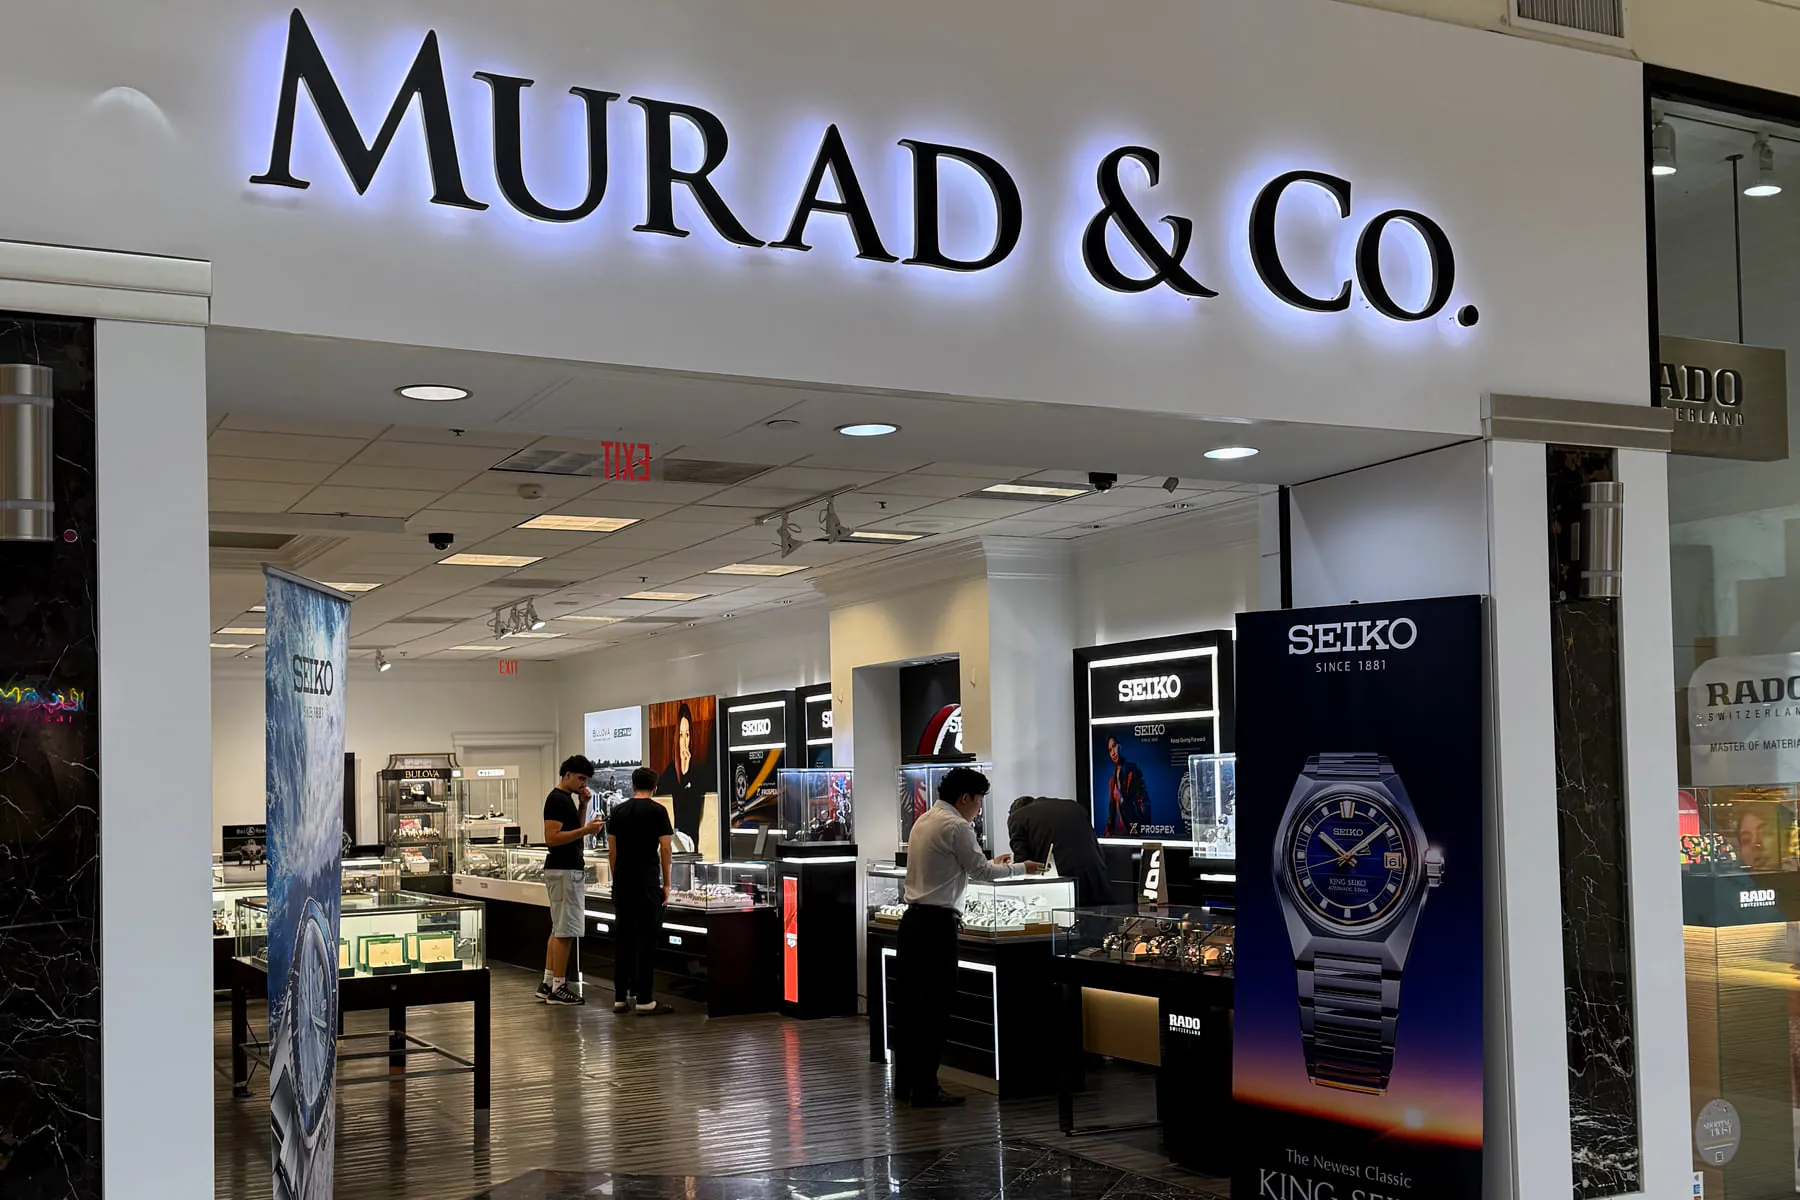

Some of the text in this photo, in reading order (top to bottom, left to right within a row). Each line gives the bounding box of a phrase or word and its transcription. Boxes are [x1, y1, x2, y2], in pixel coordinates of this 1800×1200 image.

[250, 8, 1022, 272] MURAD
[1082, 146, 1219, 298] &
[1660, 362, 1743, 407] ADO
[1675, 407, 1744, 426] ERLAND
[1288, 617, 1418, 655] SEIKO
[293, 654, 333, 696] SEIKO
[499, 660, 518, 674] EXIT
[1316, 660, 1387, 673] SINCE 1881
[1119, 675, 1181, 701] SEIKO
[1708, 708, 1800, 721] SWITZERLAN
[742, 719, 771, 736] SEIKO
[1134, 724, 1165, 736] SEIKO
[1710, 742, 1745, 752] MASTER
[1749, 741, 1759, 750] OF
[405, 770, 439, 778] BULOVA
[1140, 824, 1175, 834] PROSPEX
[1333, 828, 1363, 836] SEIKO
[1740, 889, 1775, 902] RADO
[1169, 1013, 1200, 1030] RADO
[1286, 1148, 1412, 1188] The Newest Classic
[1259, 1168, 1338, 1200] KING
